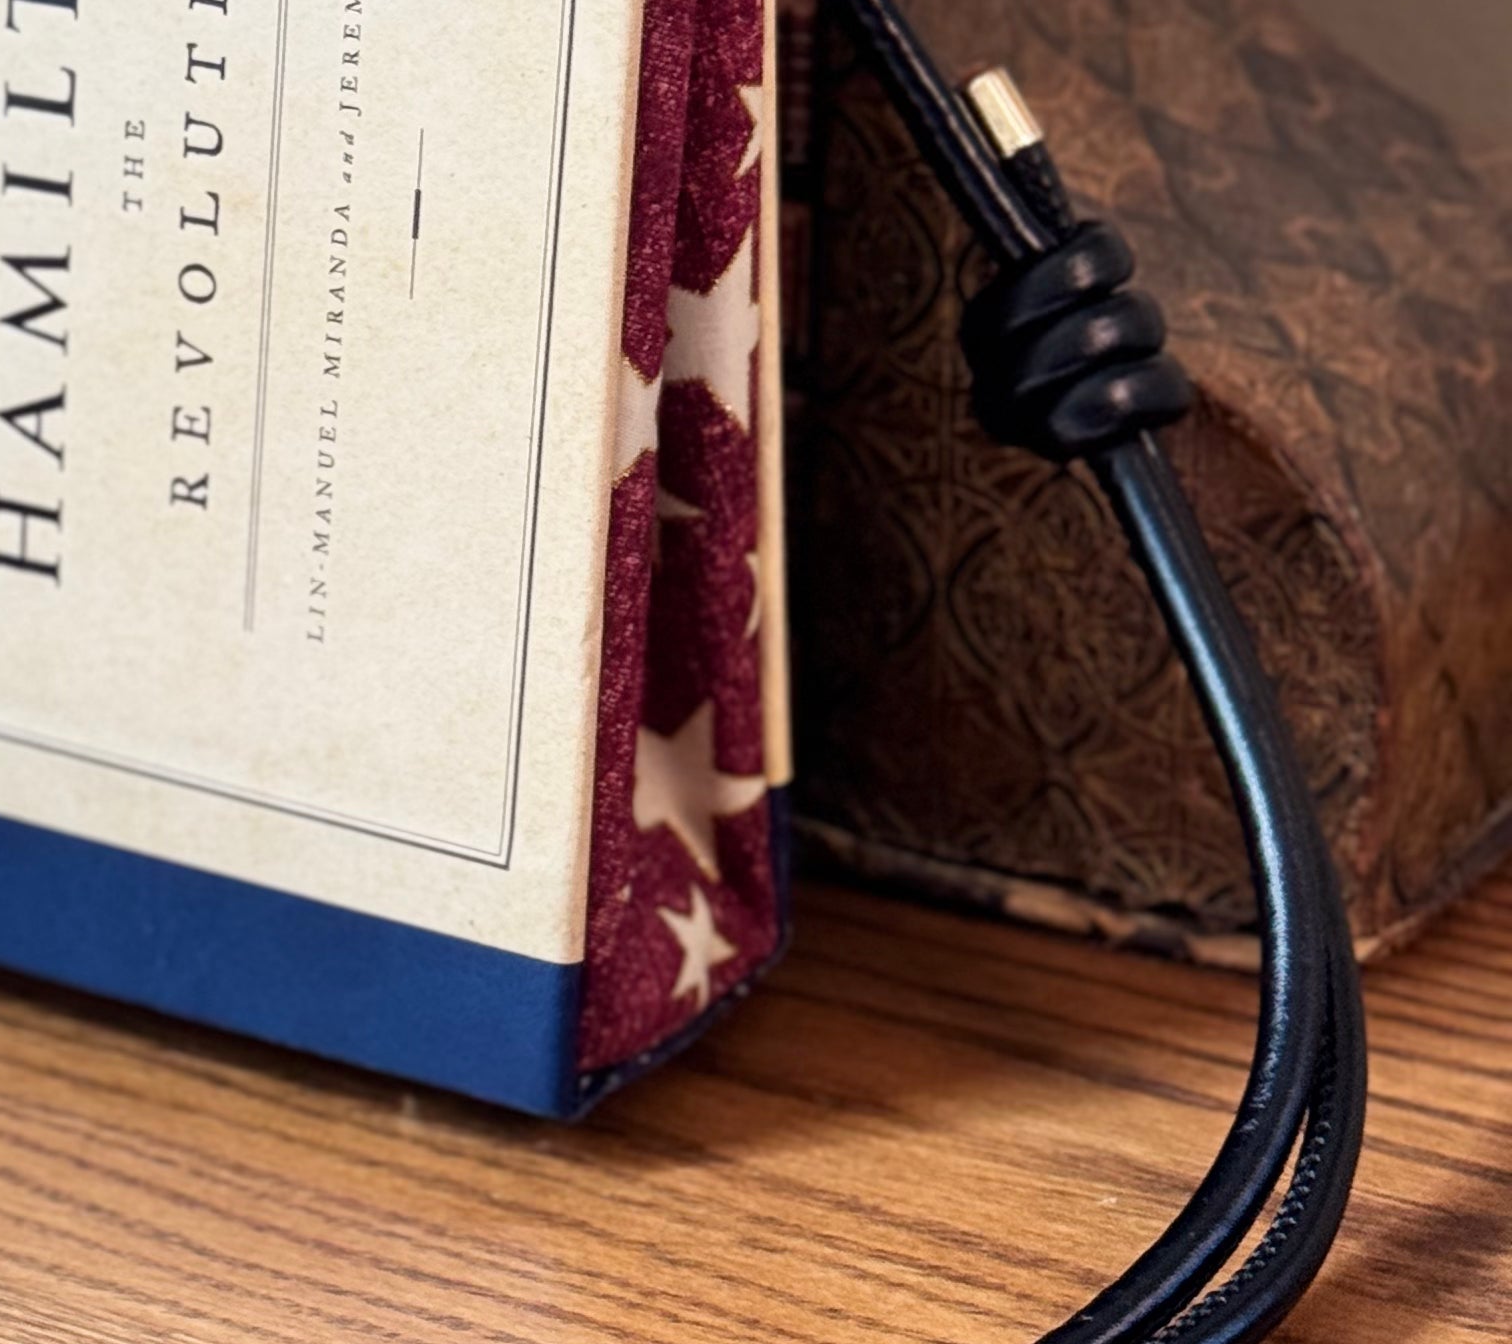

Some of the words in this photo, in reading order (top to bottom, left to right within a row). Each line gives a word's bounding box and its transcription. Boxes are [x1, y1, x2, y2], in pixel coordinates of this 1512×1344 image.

[121, 119, 146, 212] THE
[338, 130, 355, 184] and
[322, 204, 351, 379] MIRANDA
[306, 399, 339, 643] LIN-MANUEL
